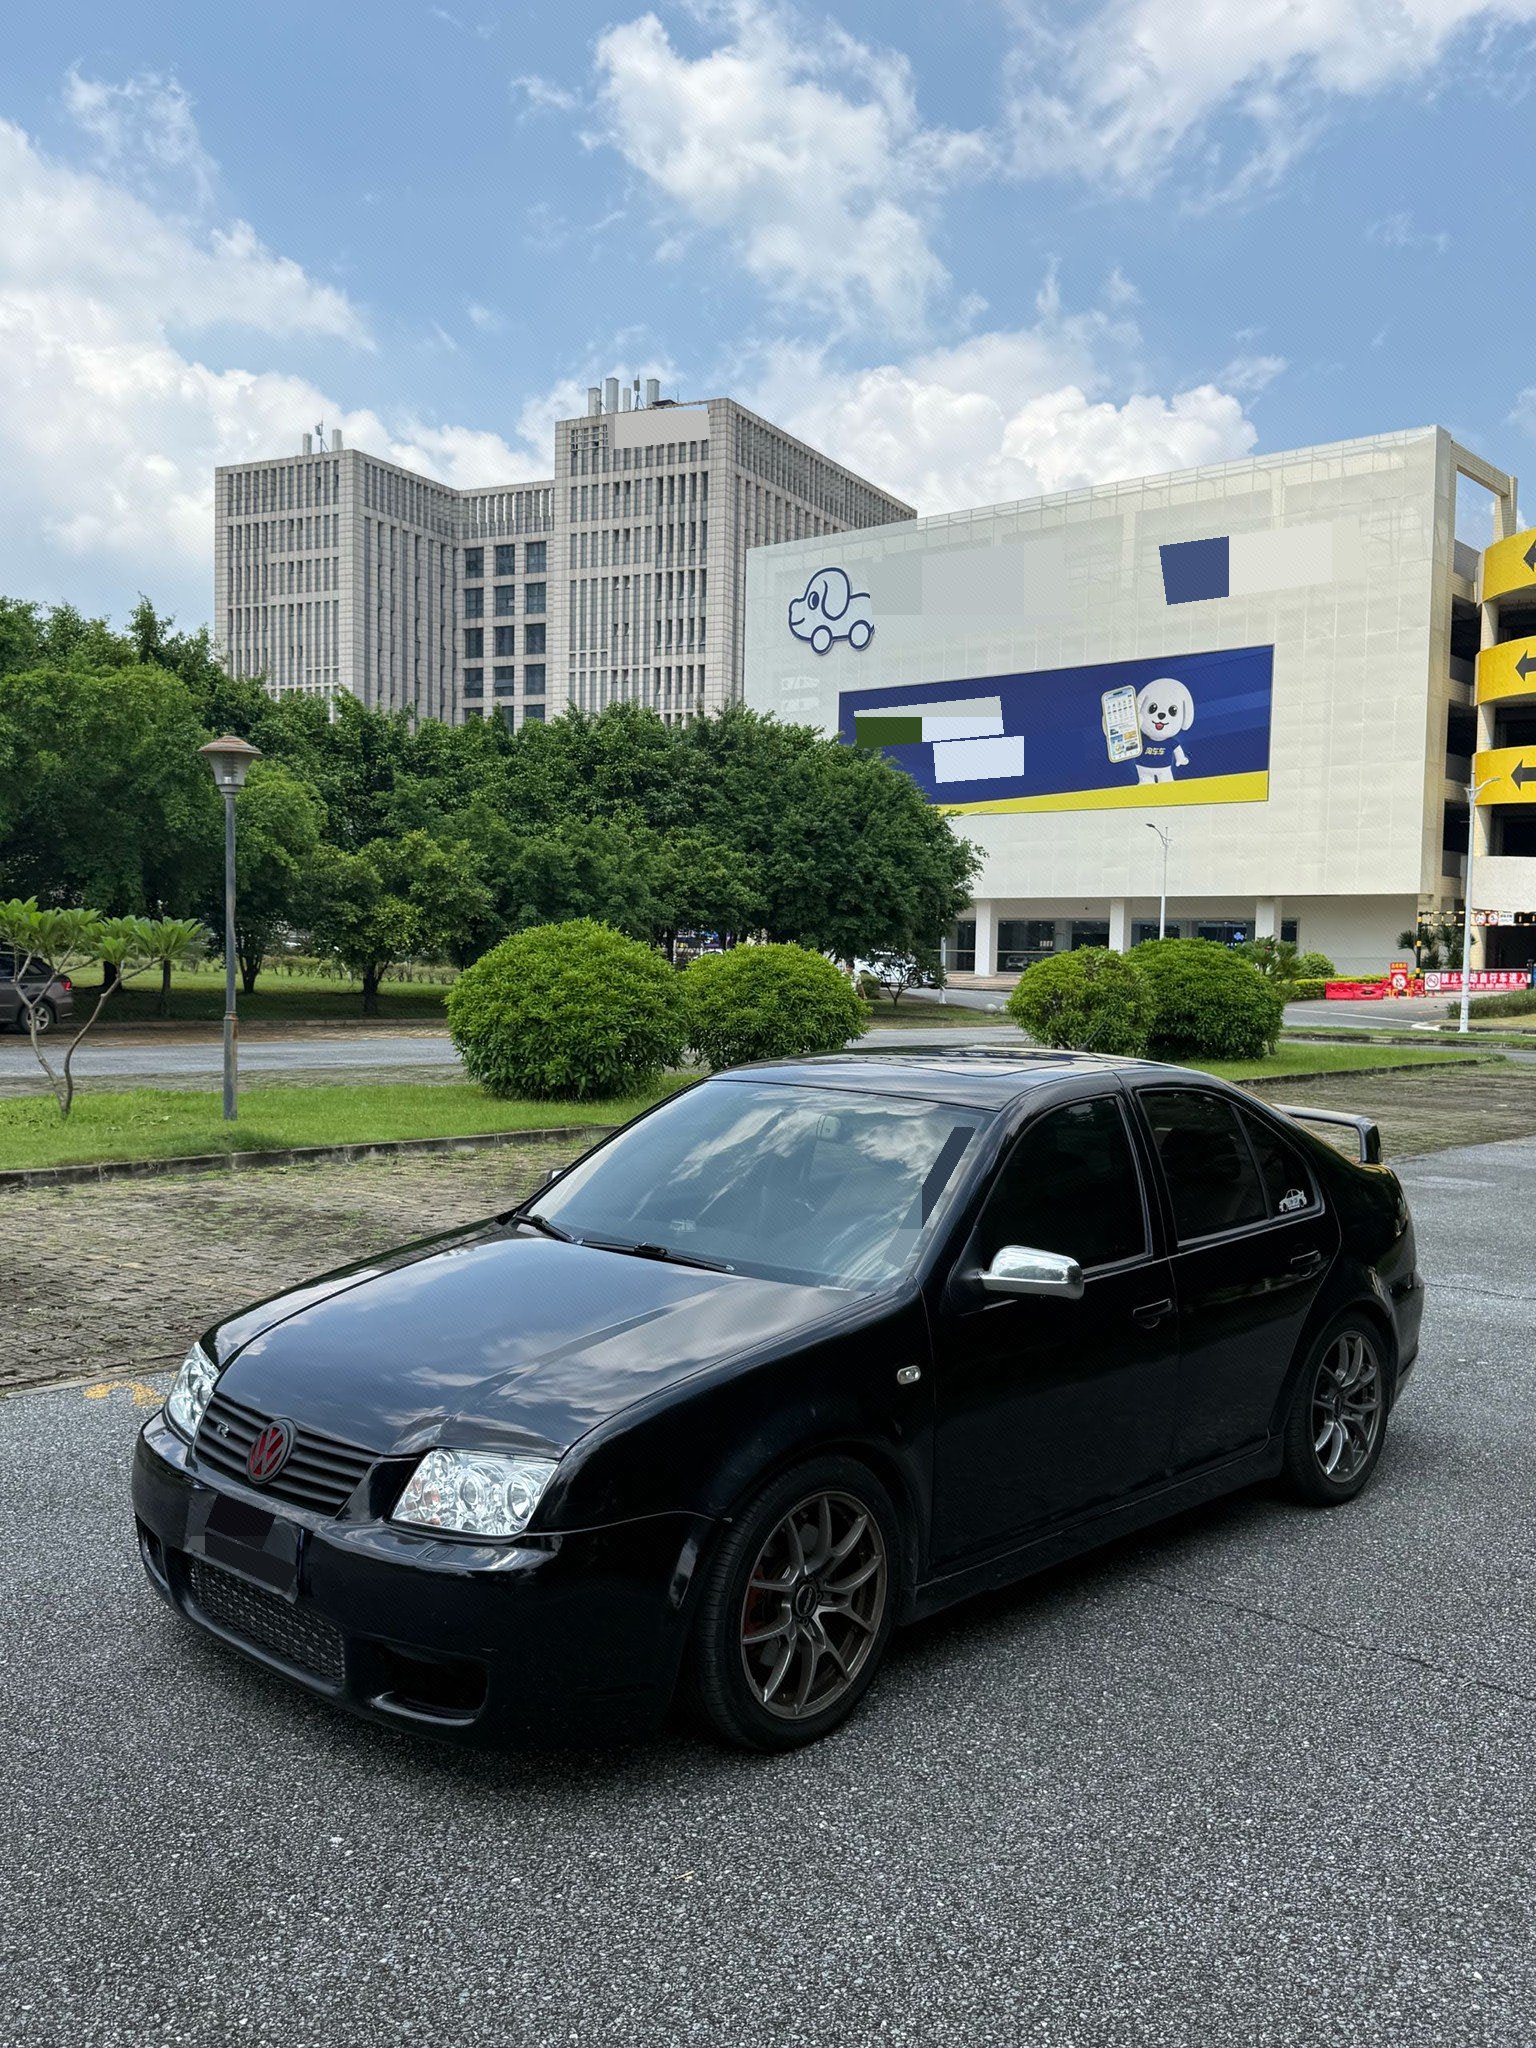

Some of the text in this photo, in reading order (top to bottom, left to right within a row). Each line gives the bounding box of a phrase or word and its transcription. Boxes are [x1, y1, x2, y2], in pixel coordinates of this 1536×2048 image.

[1441, 973, 1527, 983] 禁止动自行车进入
